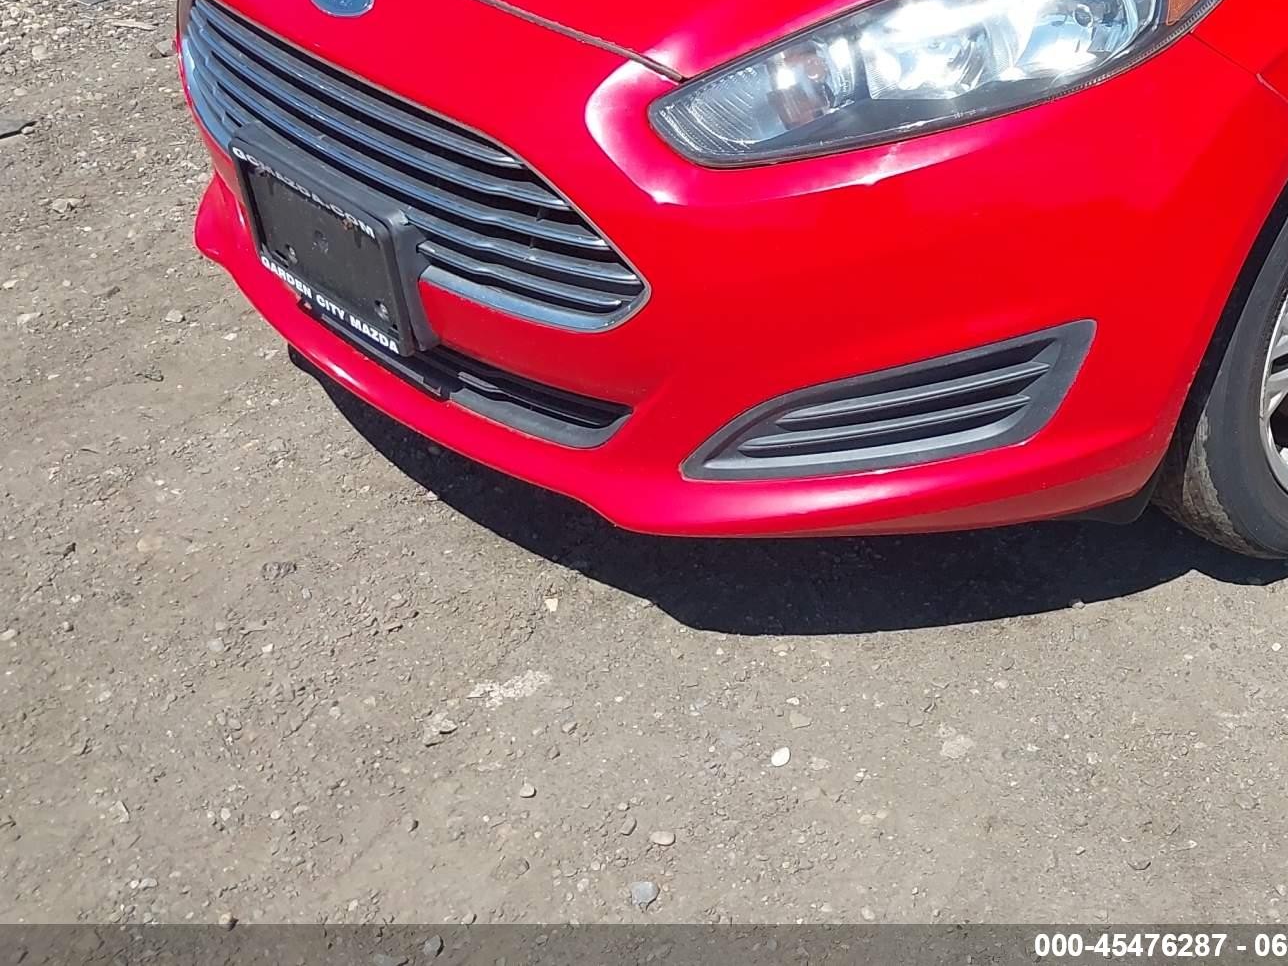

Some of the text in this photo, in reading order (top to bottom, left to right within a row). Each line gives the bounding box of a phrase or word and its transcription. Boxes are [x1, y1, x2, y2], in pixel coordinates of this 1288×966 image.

[260, 255, 400, 355] GARDEN CITY MAZDA
